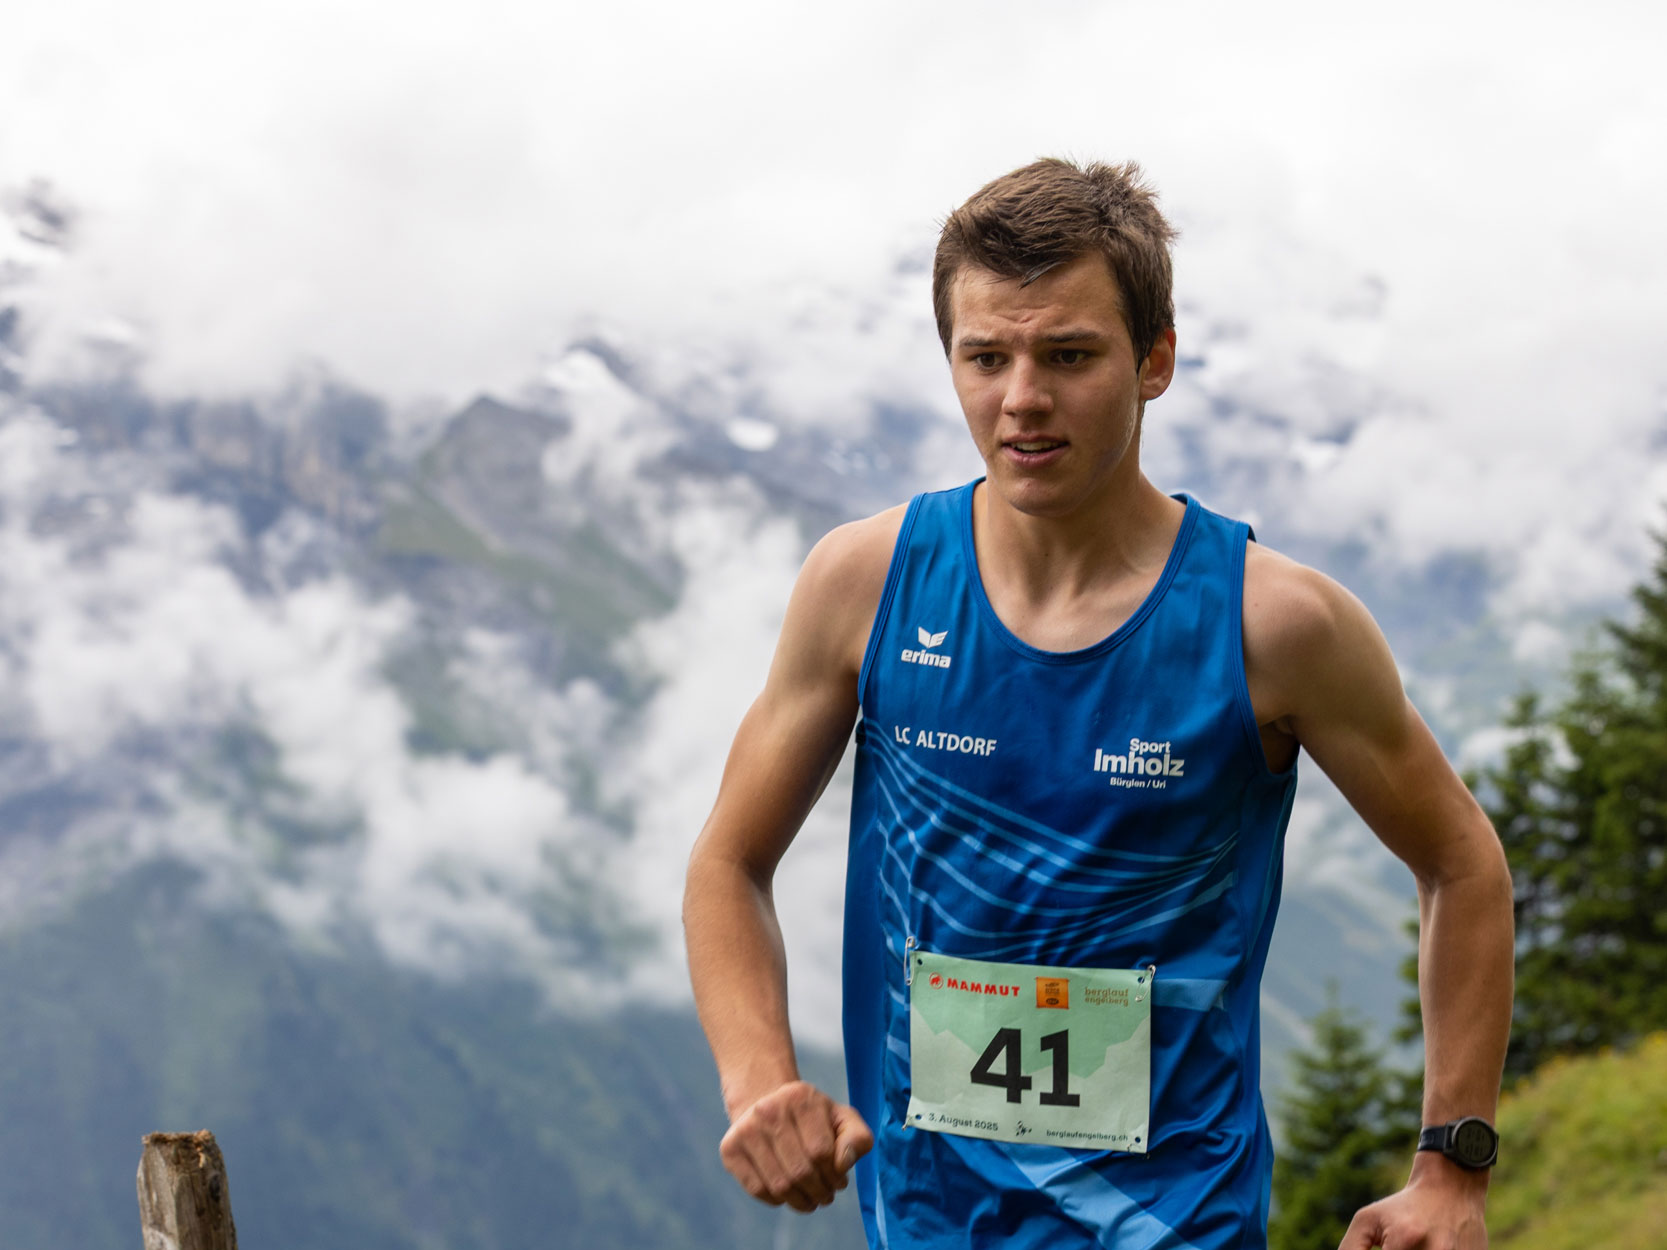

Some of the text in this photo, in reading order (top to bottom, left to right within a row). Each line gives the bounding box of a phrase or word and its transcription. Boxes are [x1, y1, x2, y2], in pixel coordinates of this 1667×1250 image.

[901, 649, 951, 668] erima
[895, 725, 998, 756] LC ALTDORF
[1129, 738, 1171, 755] Sport
[1094, 748, 1185, 776] Imholz
[1110, 777, 1145, 788] Bürglen
[1152, 780, 1167, 789] Uri
[947, 978, 1021, 997] MAMMUT
[970, 1027, 1081, 1107] 41
[939, 1115, 972, 1127] August
[974, 1119, 999, 1131] 2025
[1046, 1130, 1129, 1142] berglaufengelberg.ch
